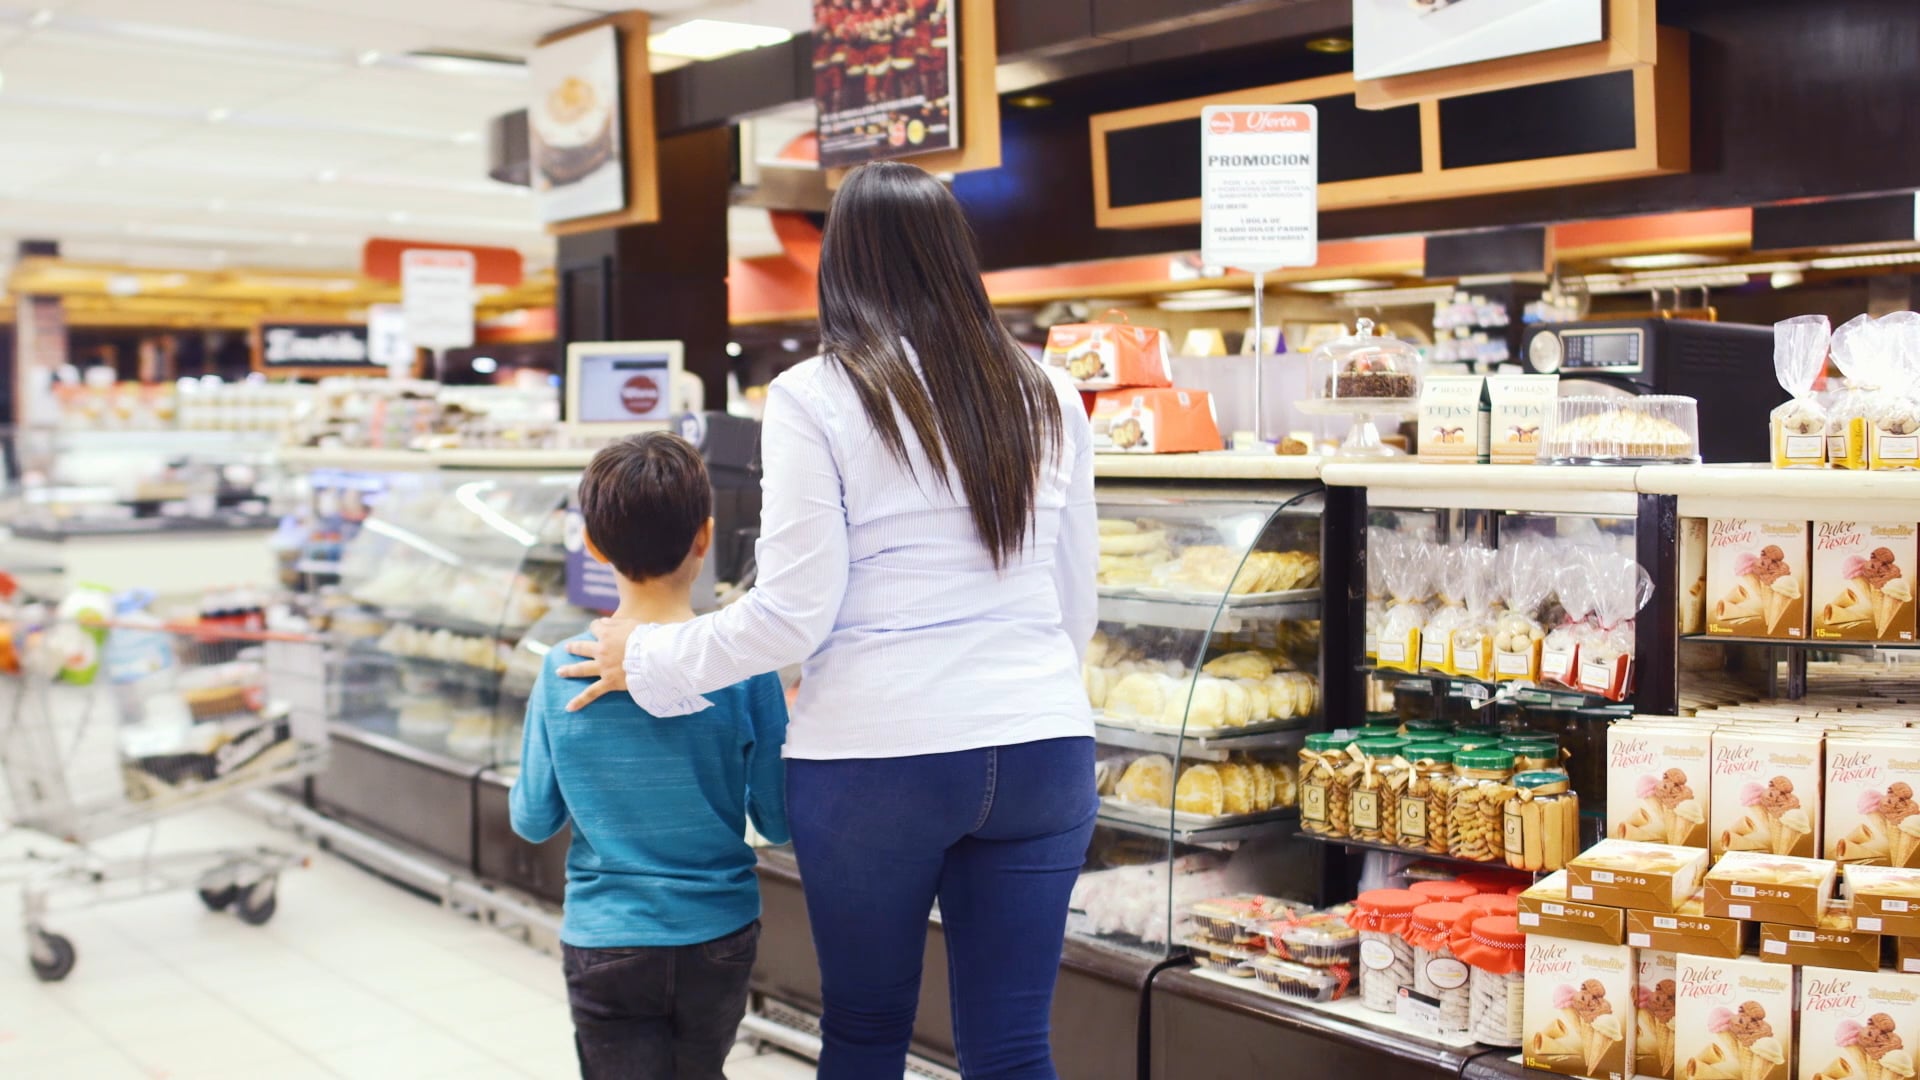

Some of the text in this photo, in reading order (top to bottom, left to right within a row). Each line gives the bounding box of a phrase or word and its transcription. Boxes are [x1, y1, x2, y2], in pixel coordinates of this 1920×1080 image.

[1247, 111, 1297, 131] Oferta
[1208, 154, 1310, 167] PROMOCION
[1426, 405, 1471, 418] TEJAS
[1712, 518, 1747, 534] Dulce
[1818, 521, 1855, 536] Dulce
[1709, 624, 1718, 632] 15
[1816, 629, 1825, 637] 15
[1612, 738, 1647, 754] Dulce
[1717, 745, 1754, 761] Dulce
[1832, 752, 1872, 768] Dulce
[1308, 789, 1319, 804] G
[1359, 796, 1370, 811] G
[1407, 803, 1418, 819] G
[1506, 818, 1515, 834] G
[1530, 944, 1567, 960] Dulce
[1682, 966, 1722, 983] Dulce
[1808, 978, 1850, 996] Dulce
[1526, 1057, 1535, 1066] 15
